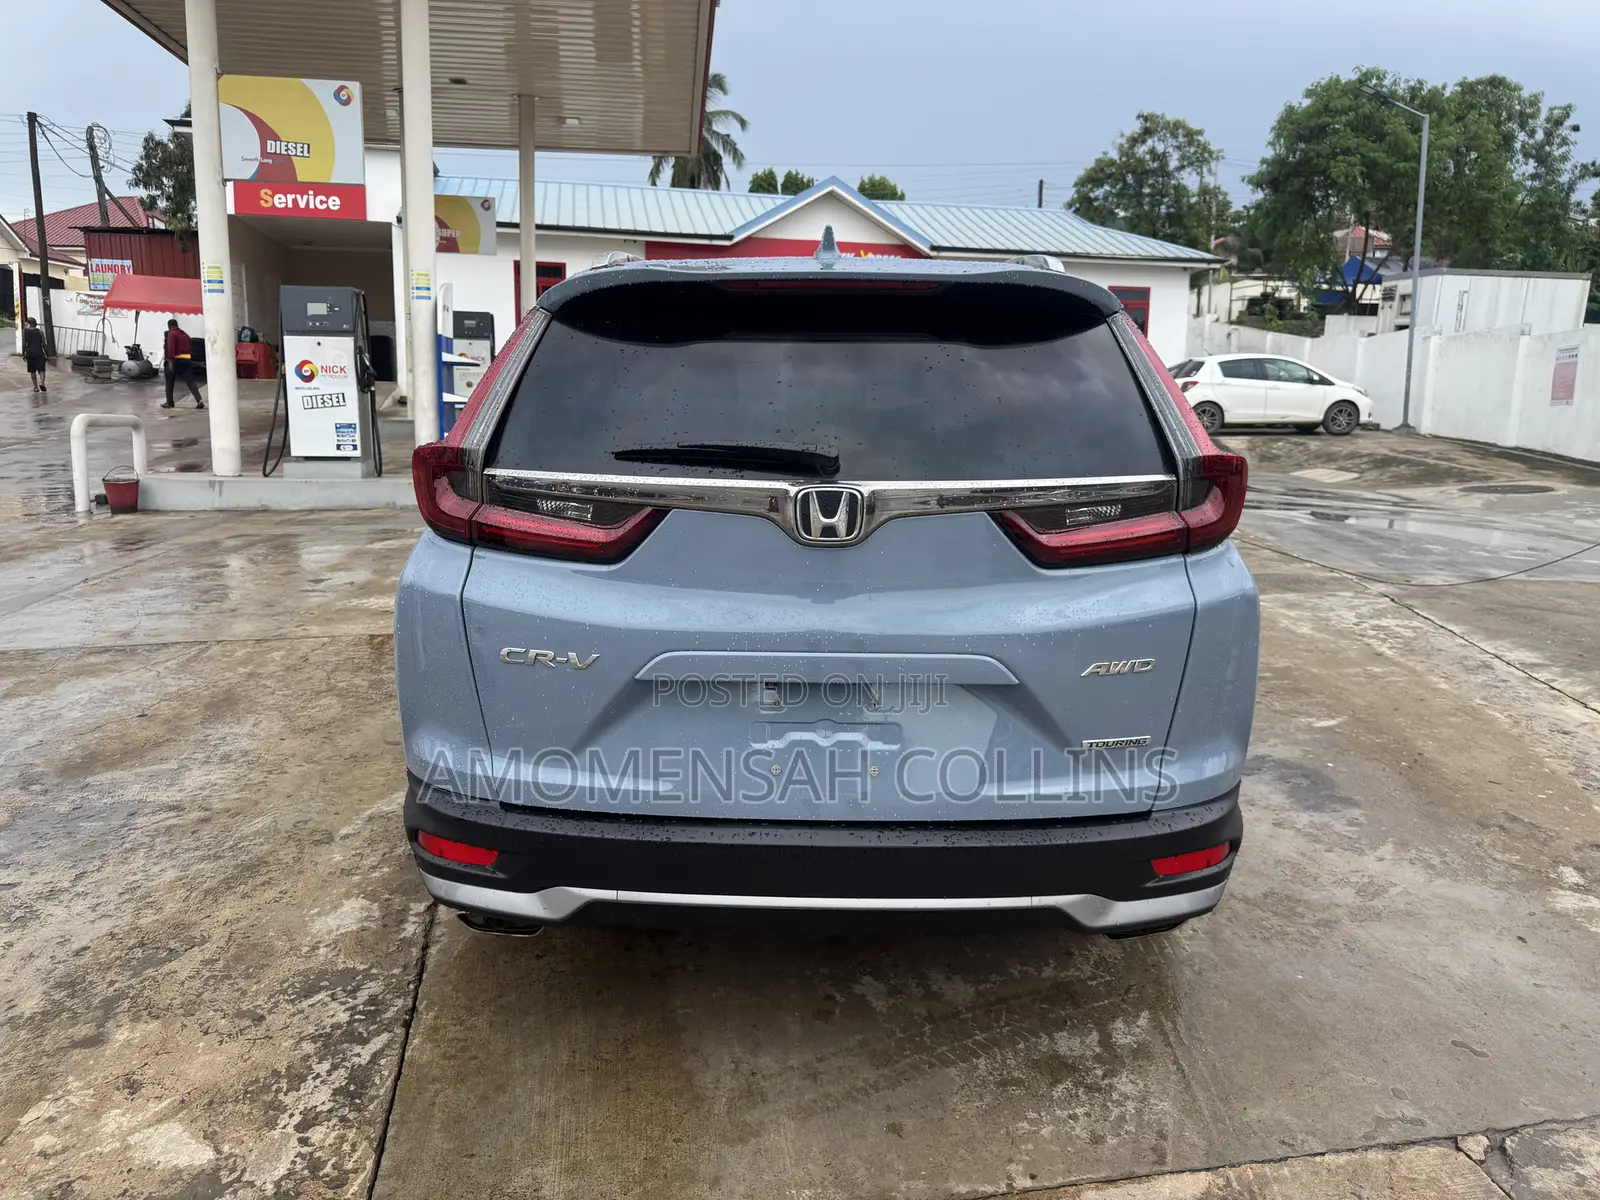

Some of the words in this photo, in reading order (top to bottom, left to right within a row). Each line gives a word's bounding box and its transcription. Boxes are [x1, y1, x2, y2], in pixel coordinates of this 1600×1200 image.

[266, 139, 310, 157] DIESEL
[259, 188, 341, 211] Service
[90, 263, 131, 275] LAUNDRY
[320, 365, 347, 374] NICK
[302, 393, 346, 409] DIESEL
[499, 647, 600, 670] CR-V
[1080, 658, 1155, 677] AWD
[1087, 738, 1148, 749] TOURING
